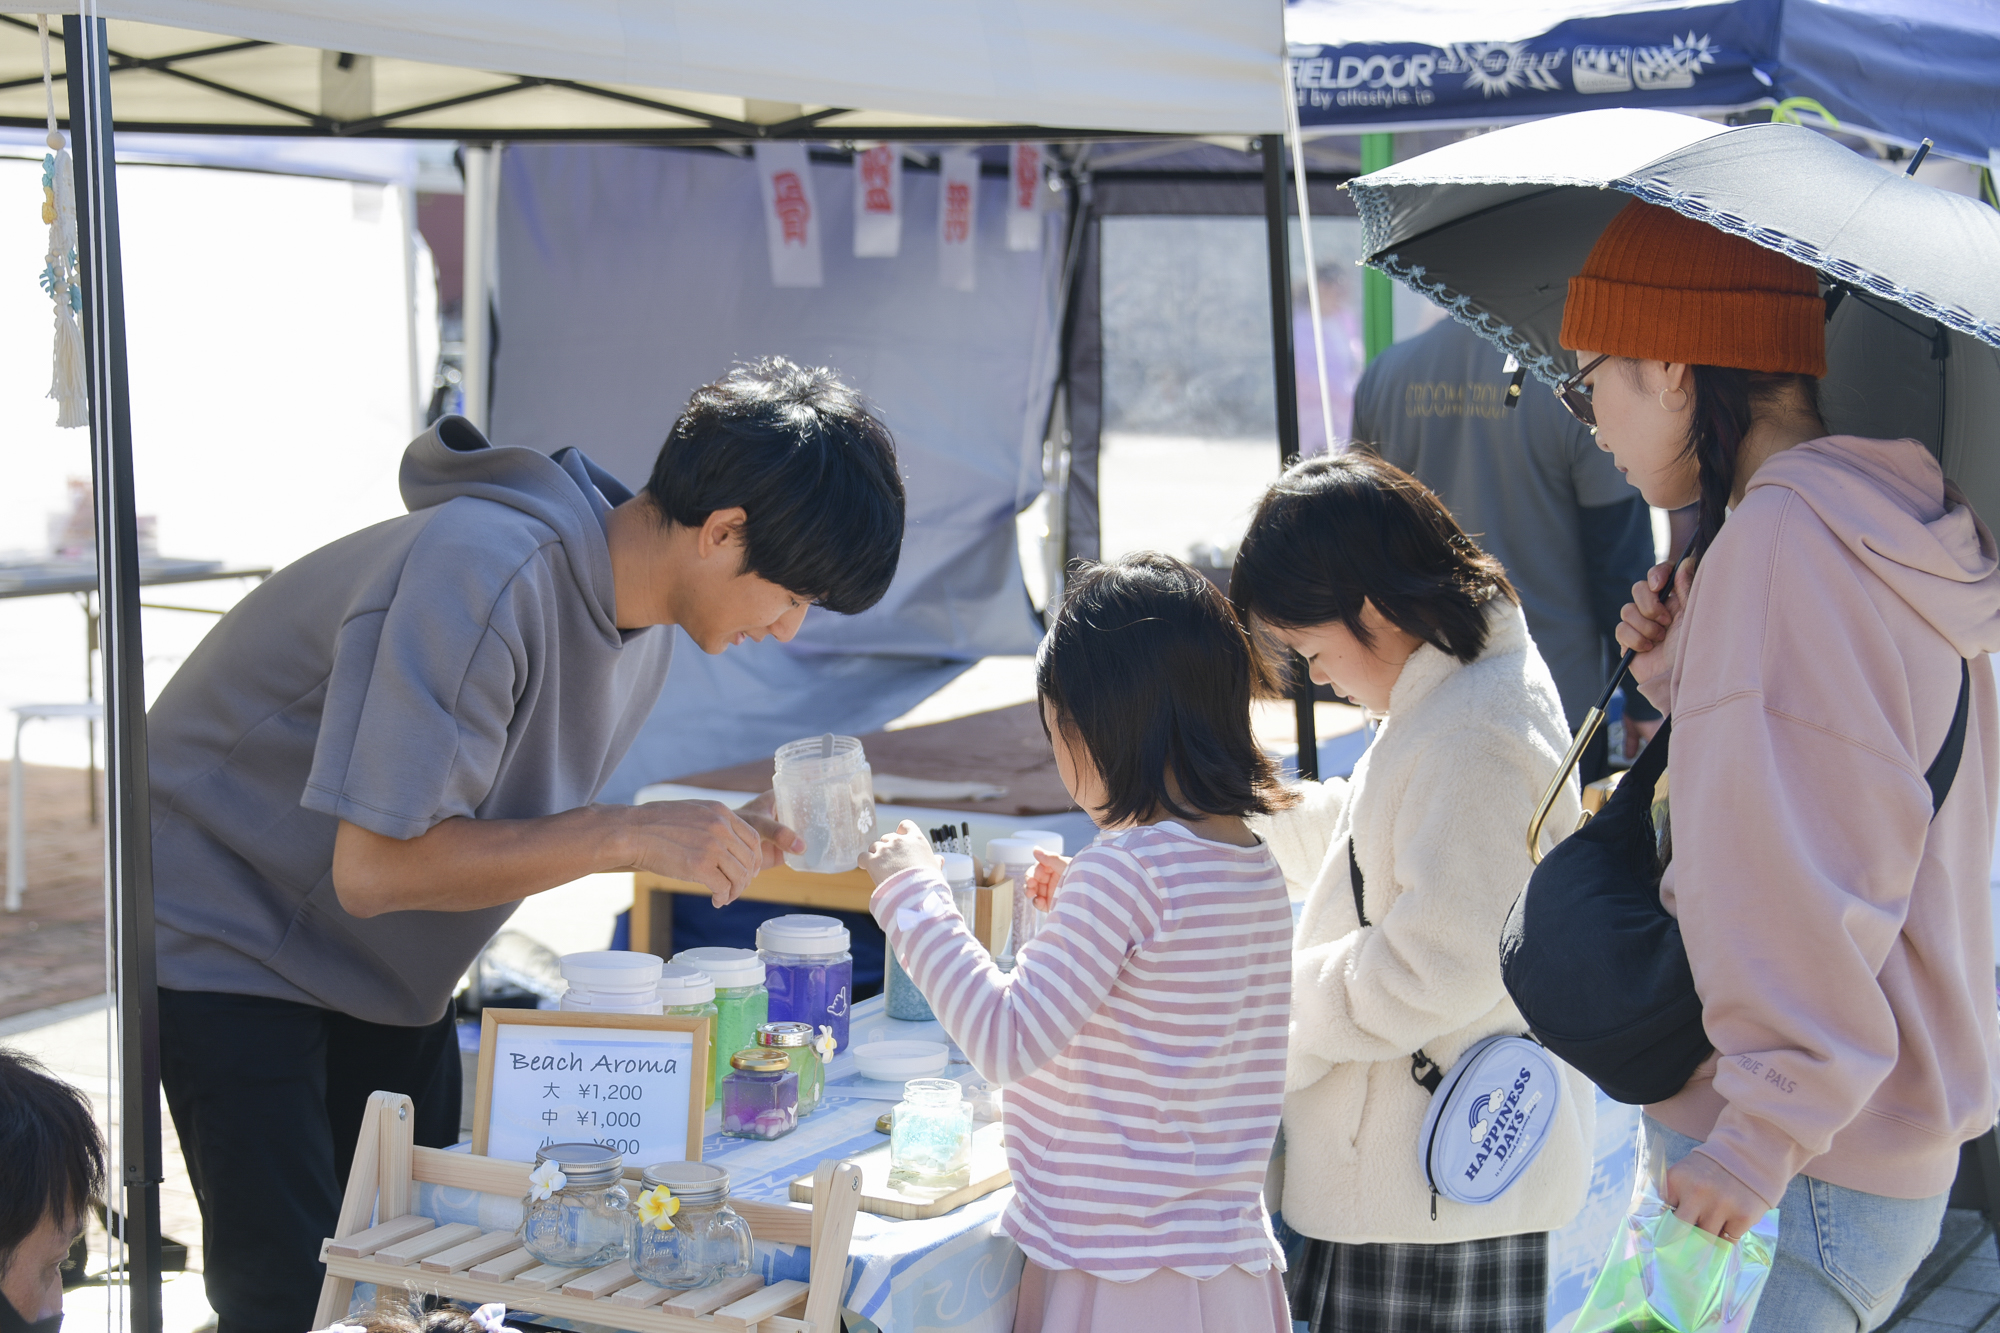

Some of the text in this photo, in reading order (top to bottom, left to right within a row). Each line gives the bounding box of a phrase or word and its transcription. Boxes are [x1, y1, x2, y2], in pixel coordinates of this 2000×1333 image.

[1310, 86, 1334, 111] by
[509, 1051, 677, 1074] Beach Aroma
[1737, 1055, 1797, 1093] TRUE PALS
[542, 1082, 643, 1101] 大 ¥1,200
[542, 1109, 641, 1128] 中 ¥1,000
[1464, 1067, 1531, 1181] HAPPINESS
[1494, 1109, 1524, 1162] DAYS
